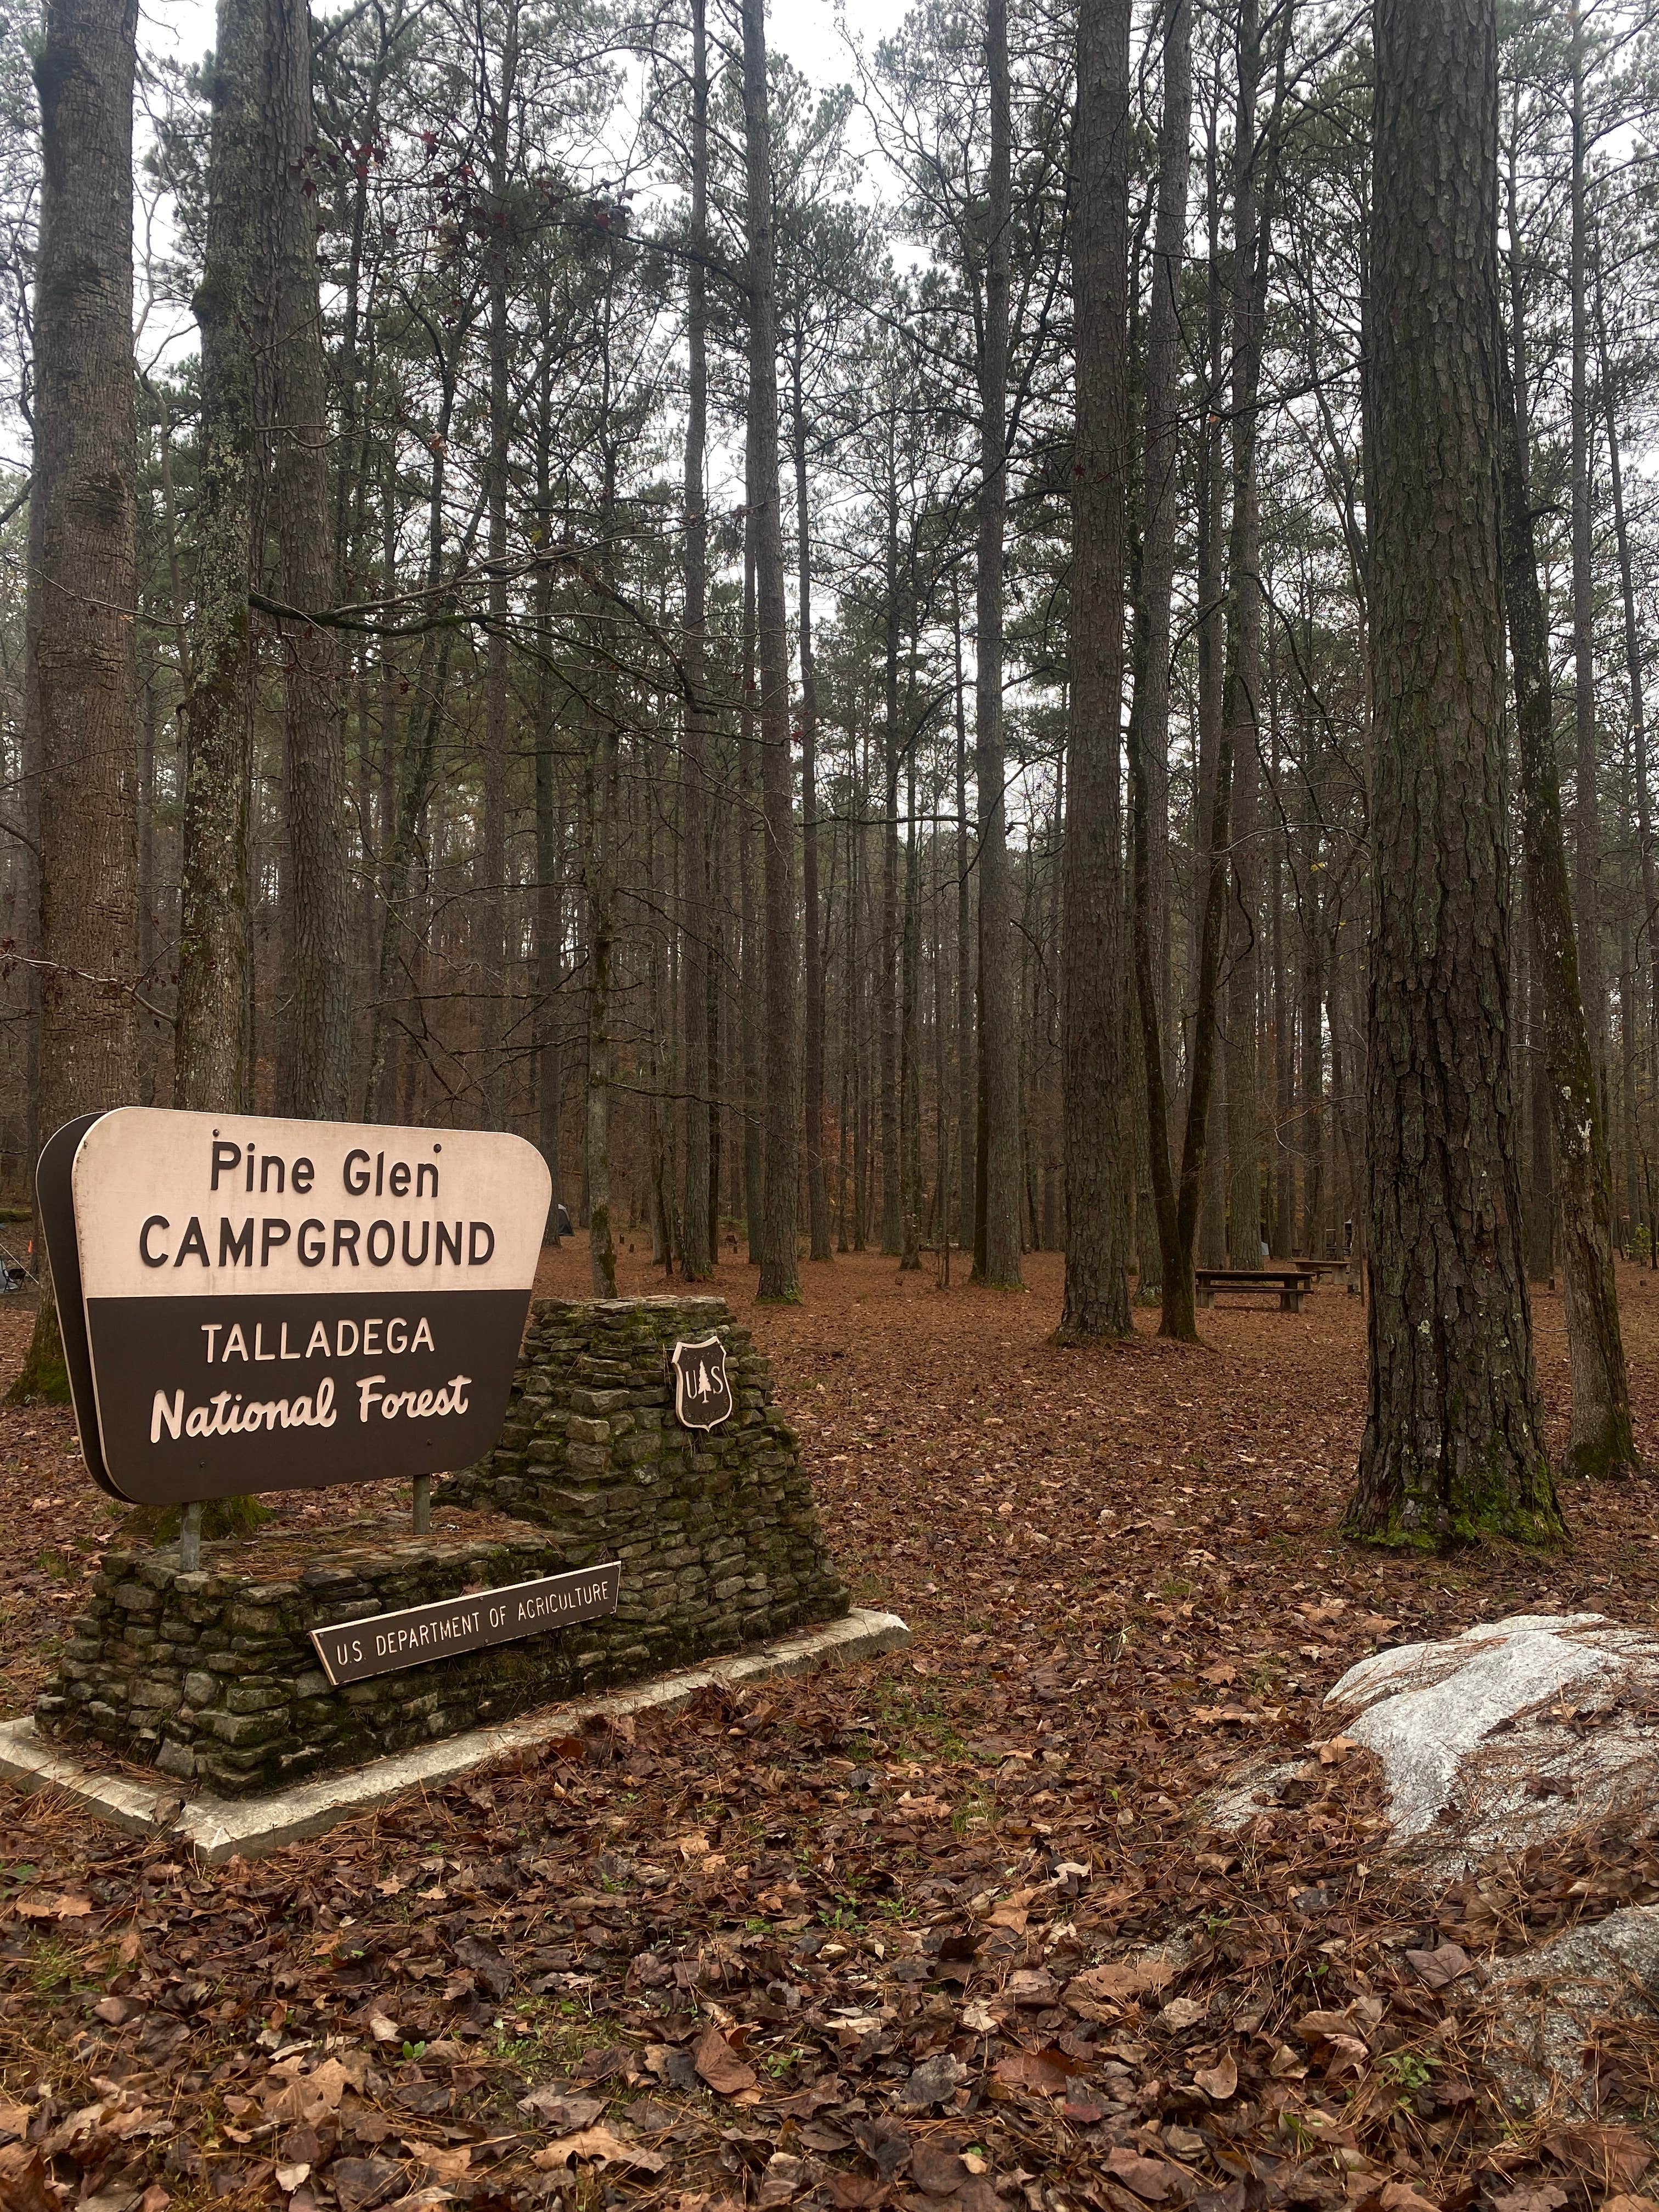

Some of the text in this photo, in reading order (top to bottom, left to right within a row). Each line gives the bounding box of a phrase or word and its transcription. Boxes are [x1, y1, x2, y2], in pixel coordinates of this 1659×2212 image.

[211, 1141, 439, 1198] Pine Glen
[139, 1214, 495, 1268] CAMPGROUND
[201, 1317, 436, 1363] TALLADEGA
[150, 1374, 472, 1444] National Forest
[376, 1612, 480, 1657] DEPARTMENT
[489, 1605, 507, 1628] OF
[517, 1581, 609, 1622] AGRICULTURE
